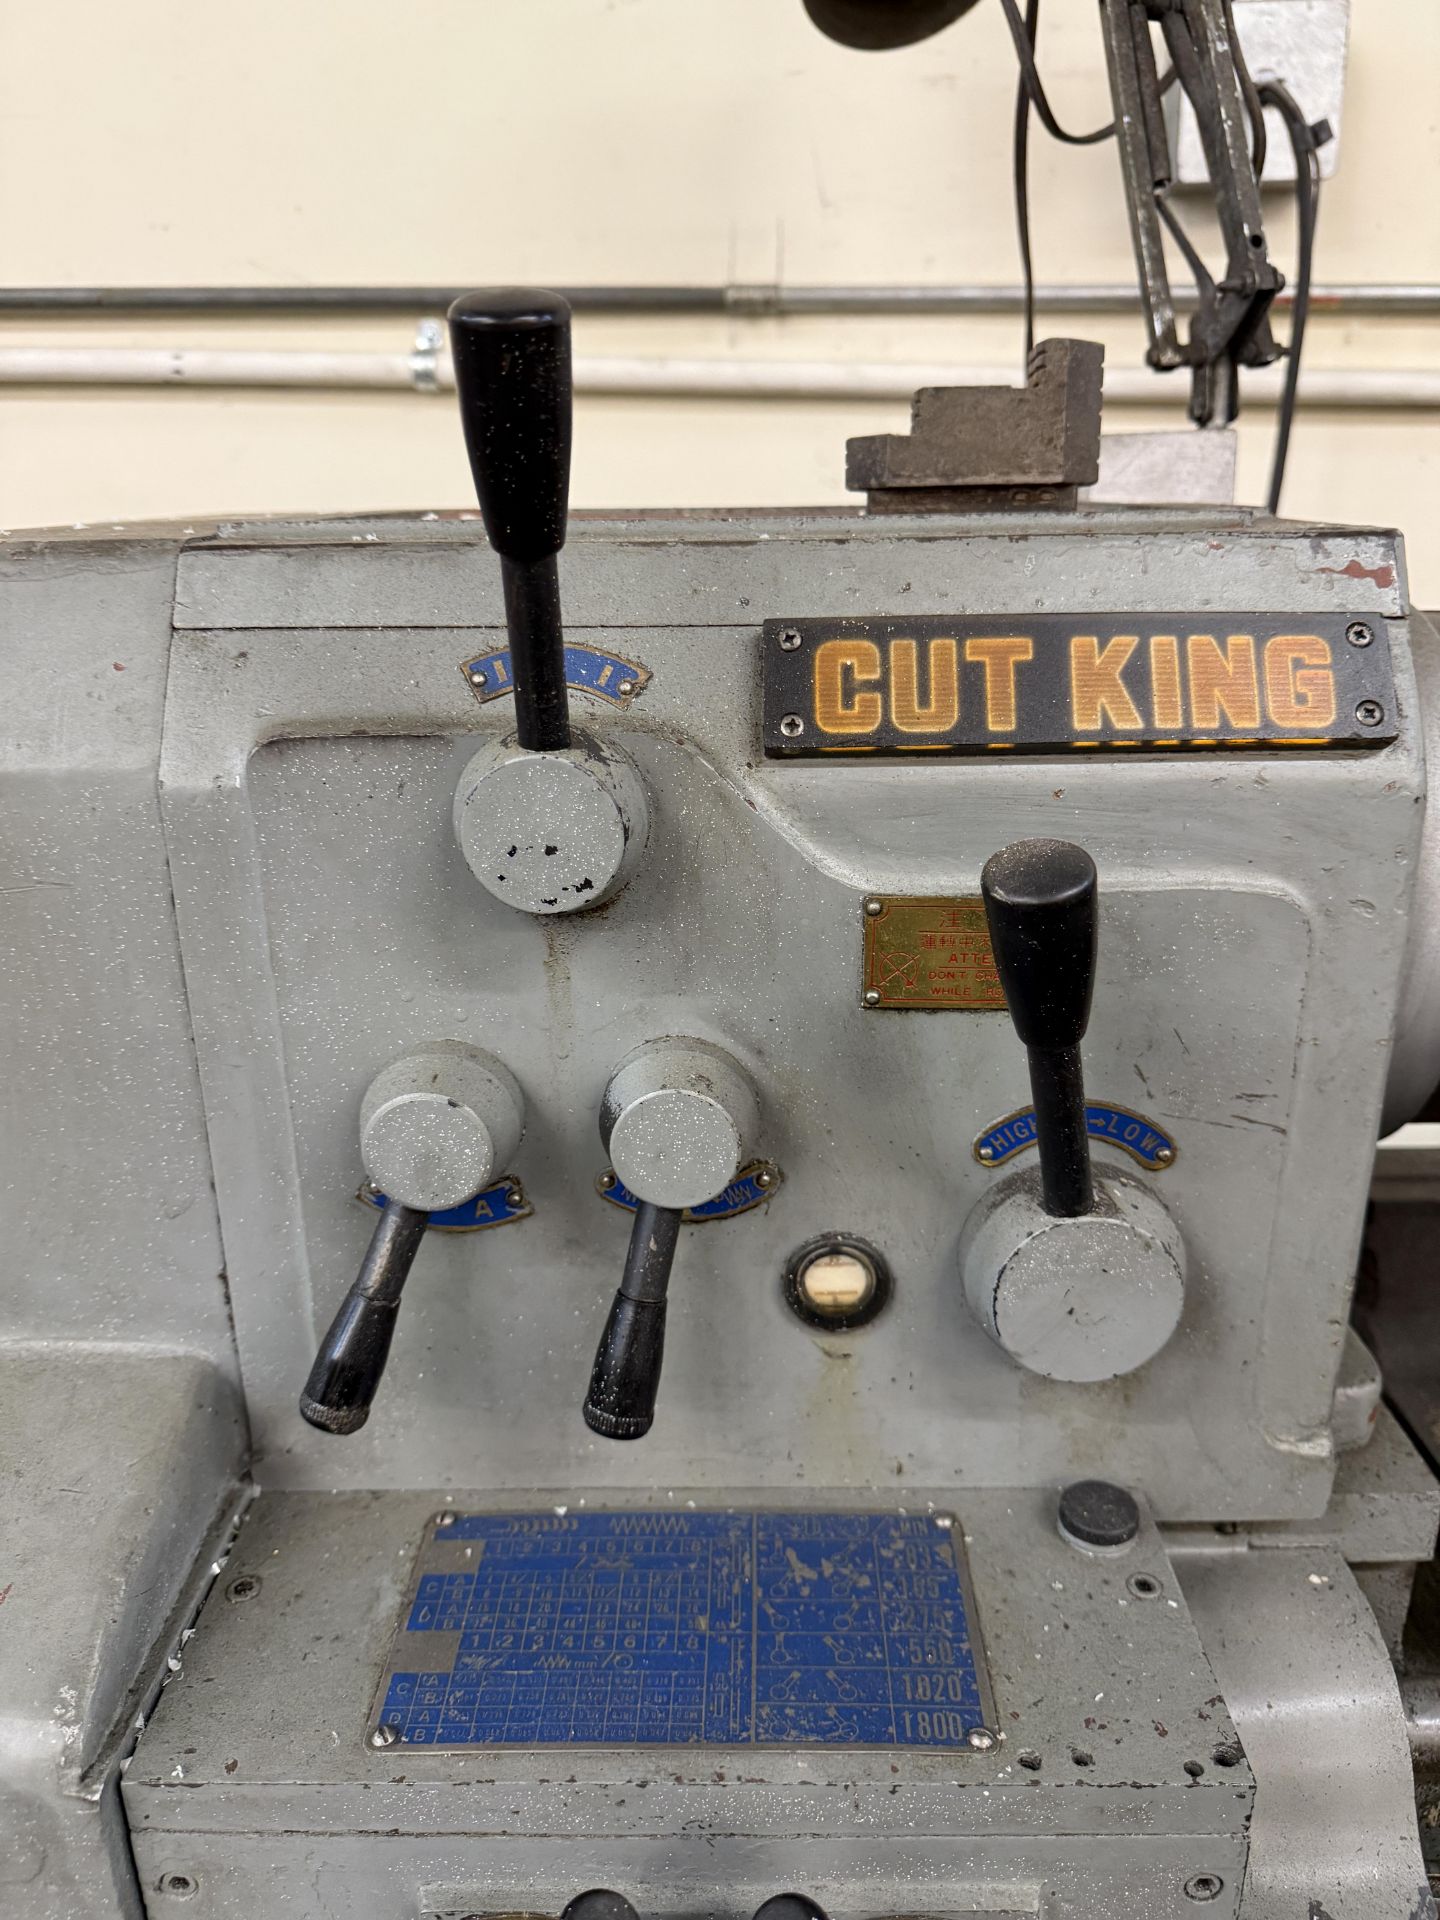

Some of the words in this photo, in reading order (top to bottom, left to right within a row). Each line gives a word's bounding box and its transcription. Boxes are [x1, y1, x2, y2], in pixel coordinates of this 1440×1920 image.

[814, 636, 1032, 735] CUT
[1071, 634, 1337, 731] KING
[928, 971, 966, 980] DONT
[930, 987, 971, 996] WHILE
[1106, 1114, 1161, 1151] LOW
[474, 1198, 495, 1219] A
[472, 1635, 480, 1648] 1
[501, 1635, 514, 1648] 2
[533, 1635, 544, 1648] 3
[563, 1635, 574, 1648] 4
[593, 1635, 605, 1648] 5
[624, 1635, 636, 1648] 6
[656, 1635, 666, 1648] 7
[686, 1635, 699, 1648] 8
[574, 1660, 597, 1668] mm
[426, 1674, 438, 1686] A
[396, 1682, 410, 1695] C
[902, 1674, 962, 1700] 1020
[424, 1691, 437, 1704] B
[389, 1712, 401, 1724] D
[418, 1710, 430, 1722] A
[903, 1711, 963, 1740] 1800
